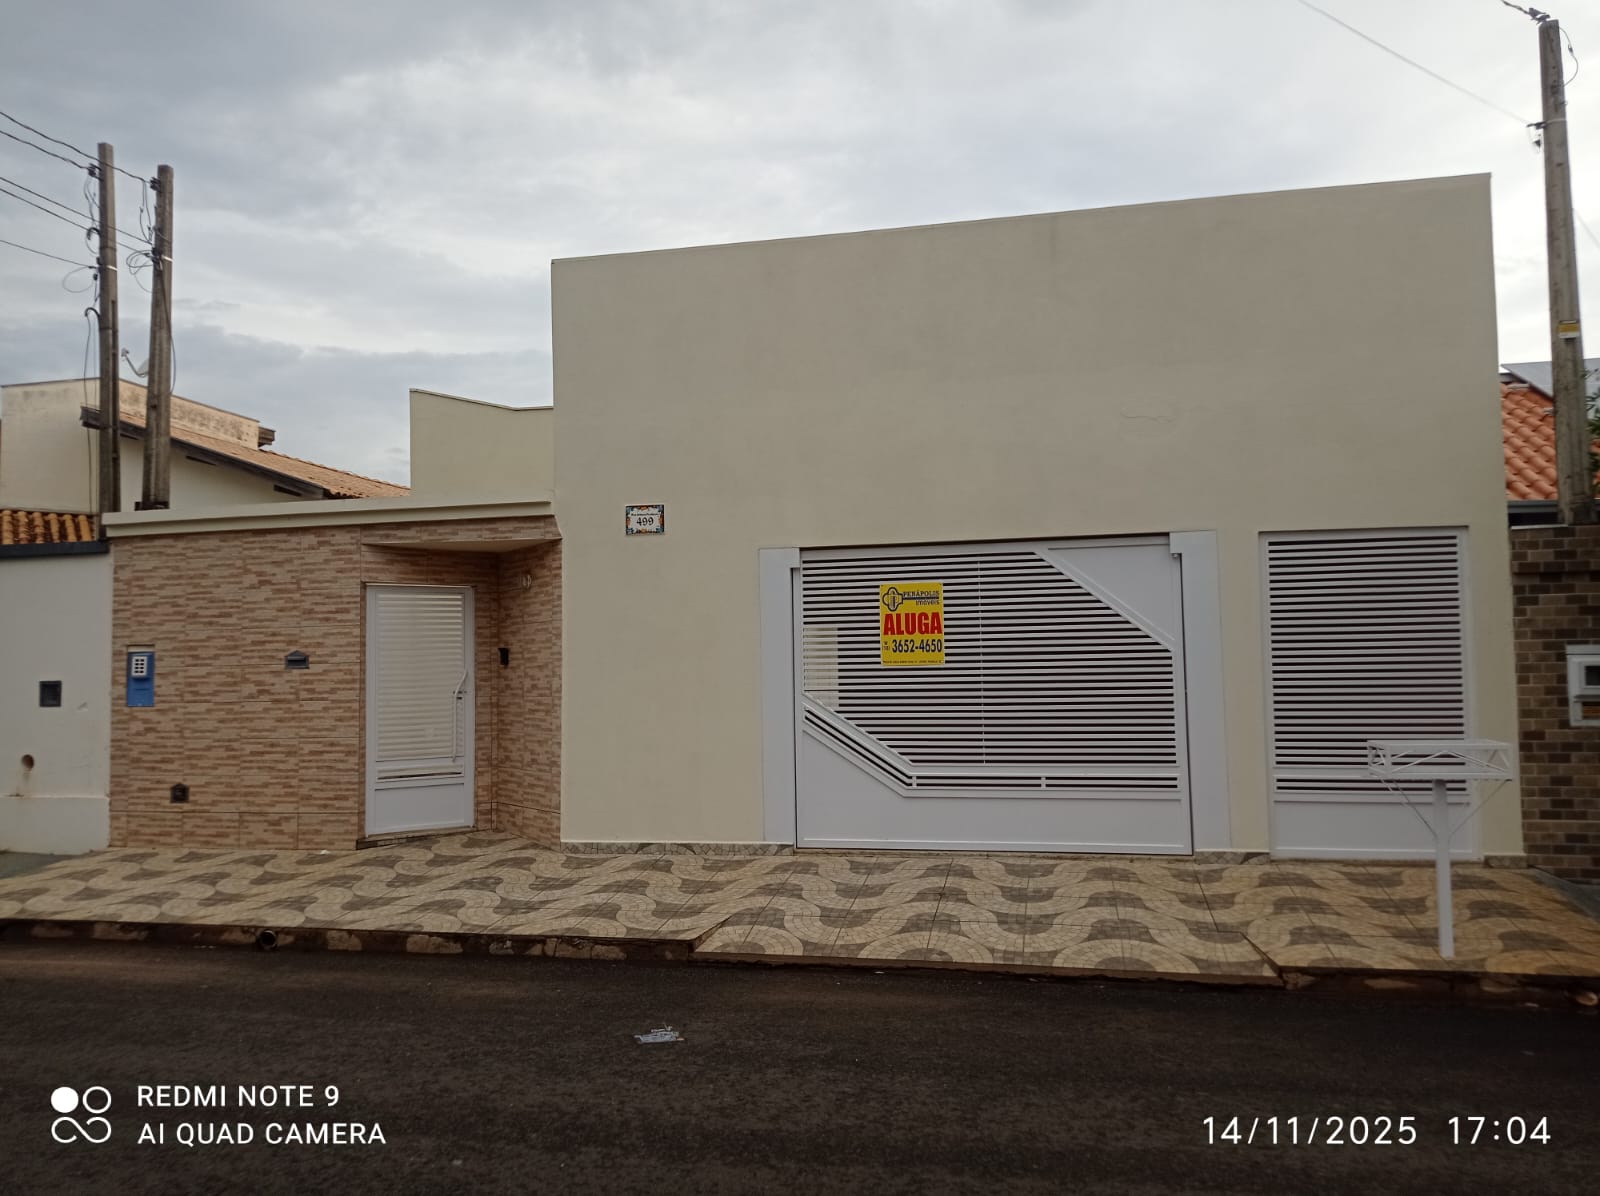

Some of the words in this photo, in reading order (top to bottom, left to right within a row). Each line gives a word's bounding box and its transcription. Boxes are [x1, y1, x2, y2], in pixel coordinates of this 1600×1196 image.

[636, 516, 654, 526] 499
[883, 611, 943, 636] ALUGA
[892, 638, 943, 653] 3652-4650
